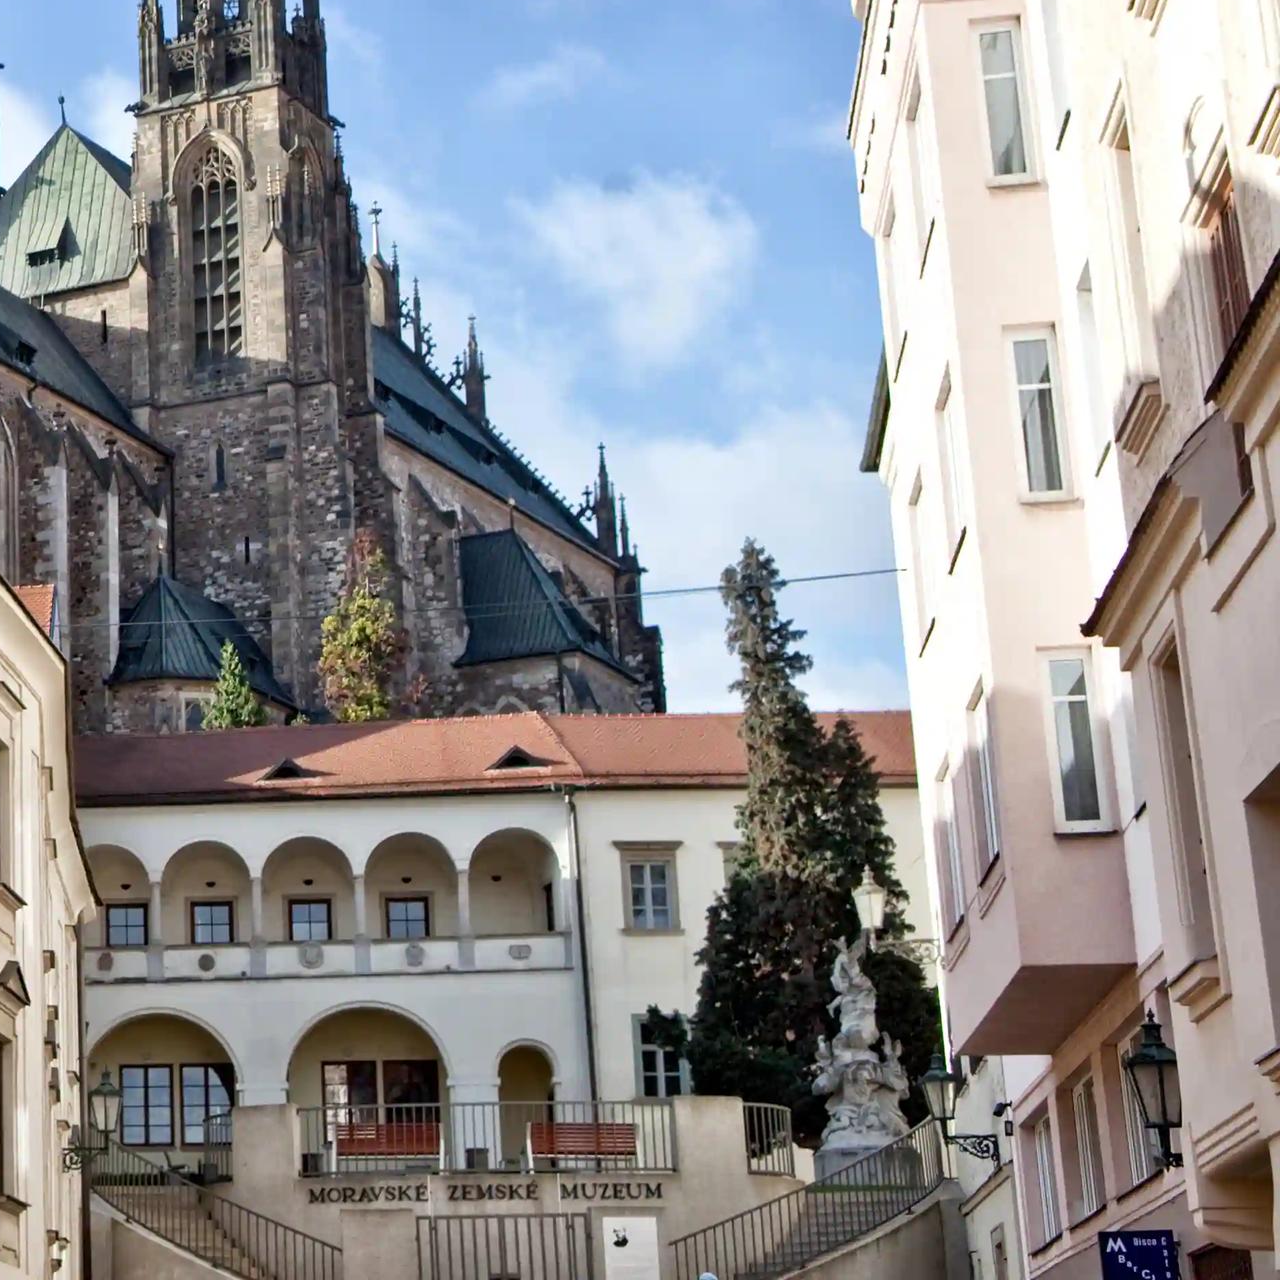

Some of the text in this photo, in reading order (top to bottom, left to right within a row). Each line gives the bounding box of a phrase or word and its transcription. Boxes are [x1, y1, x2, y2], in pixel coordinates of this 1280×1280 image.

[308, 1179, 663, 1204] MORAVSKÉ ZEMSKÉ MUZEUM
[1106, 1237, 1127, 1252] M
[1118, 1254, 1138, 1272] Bar
